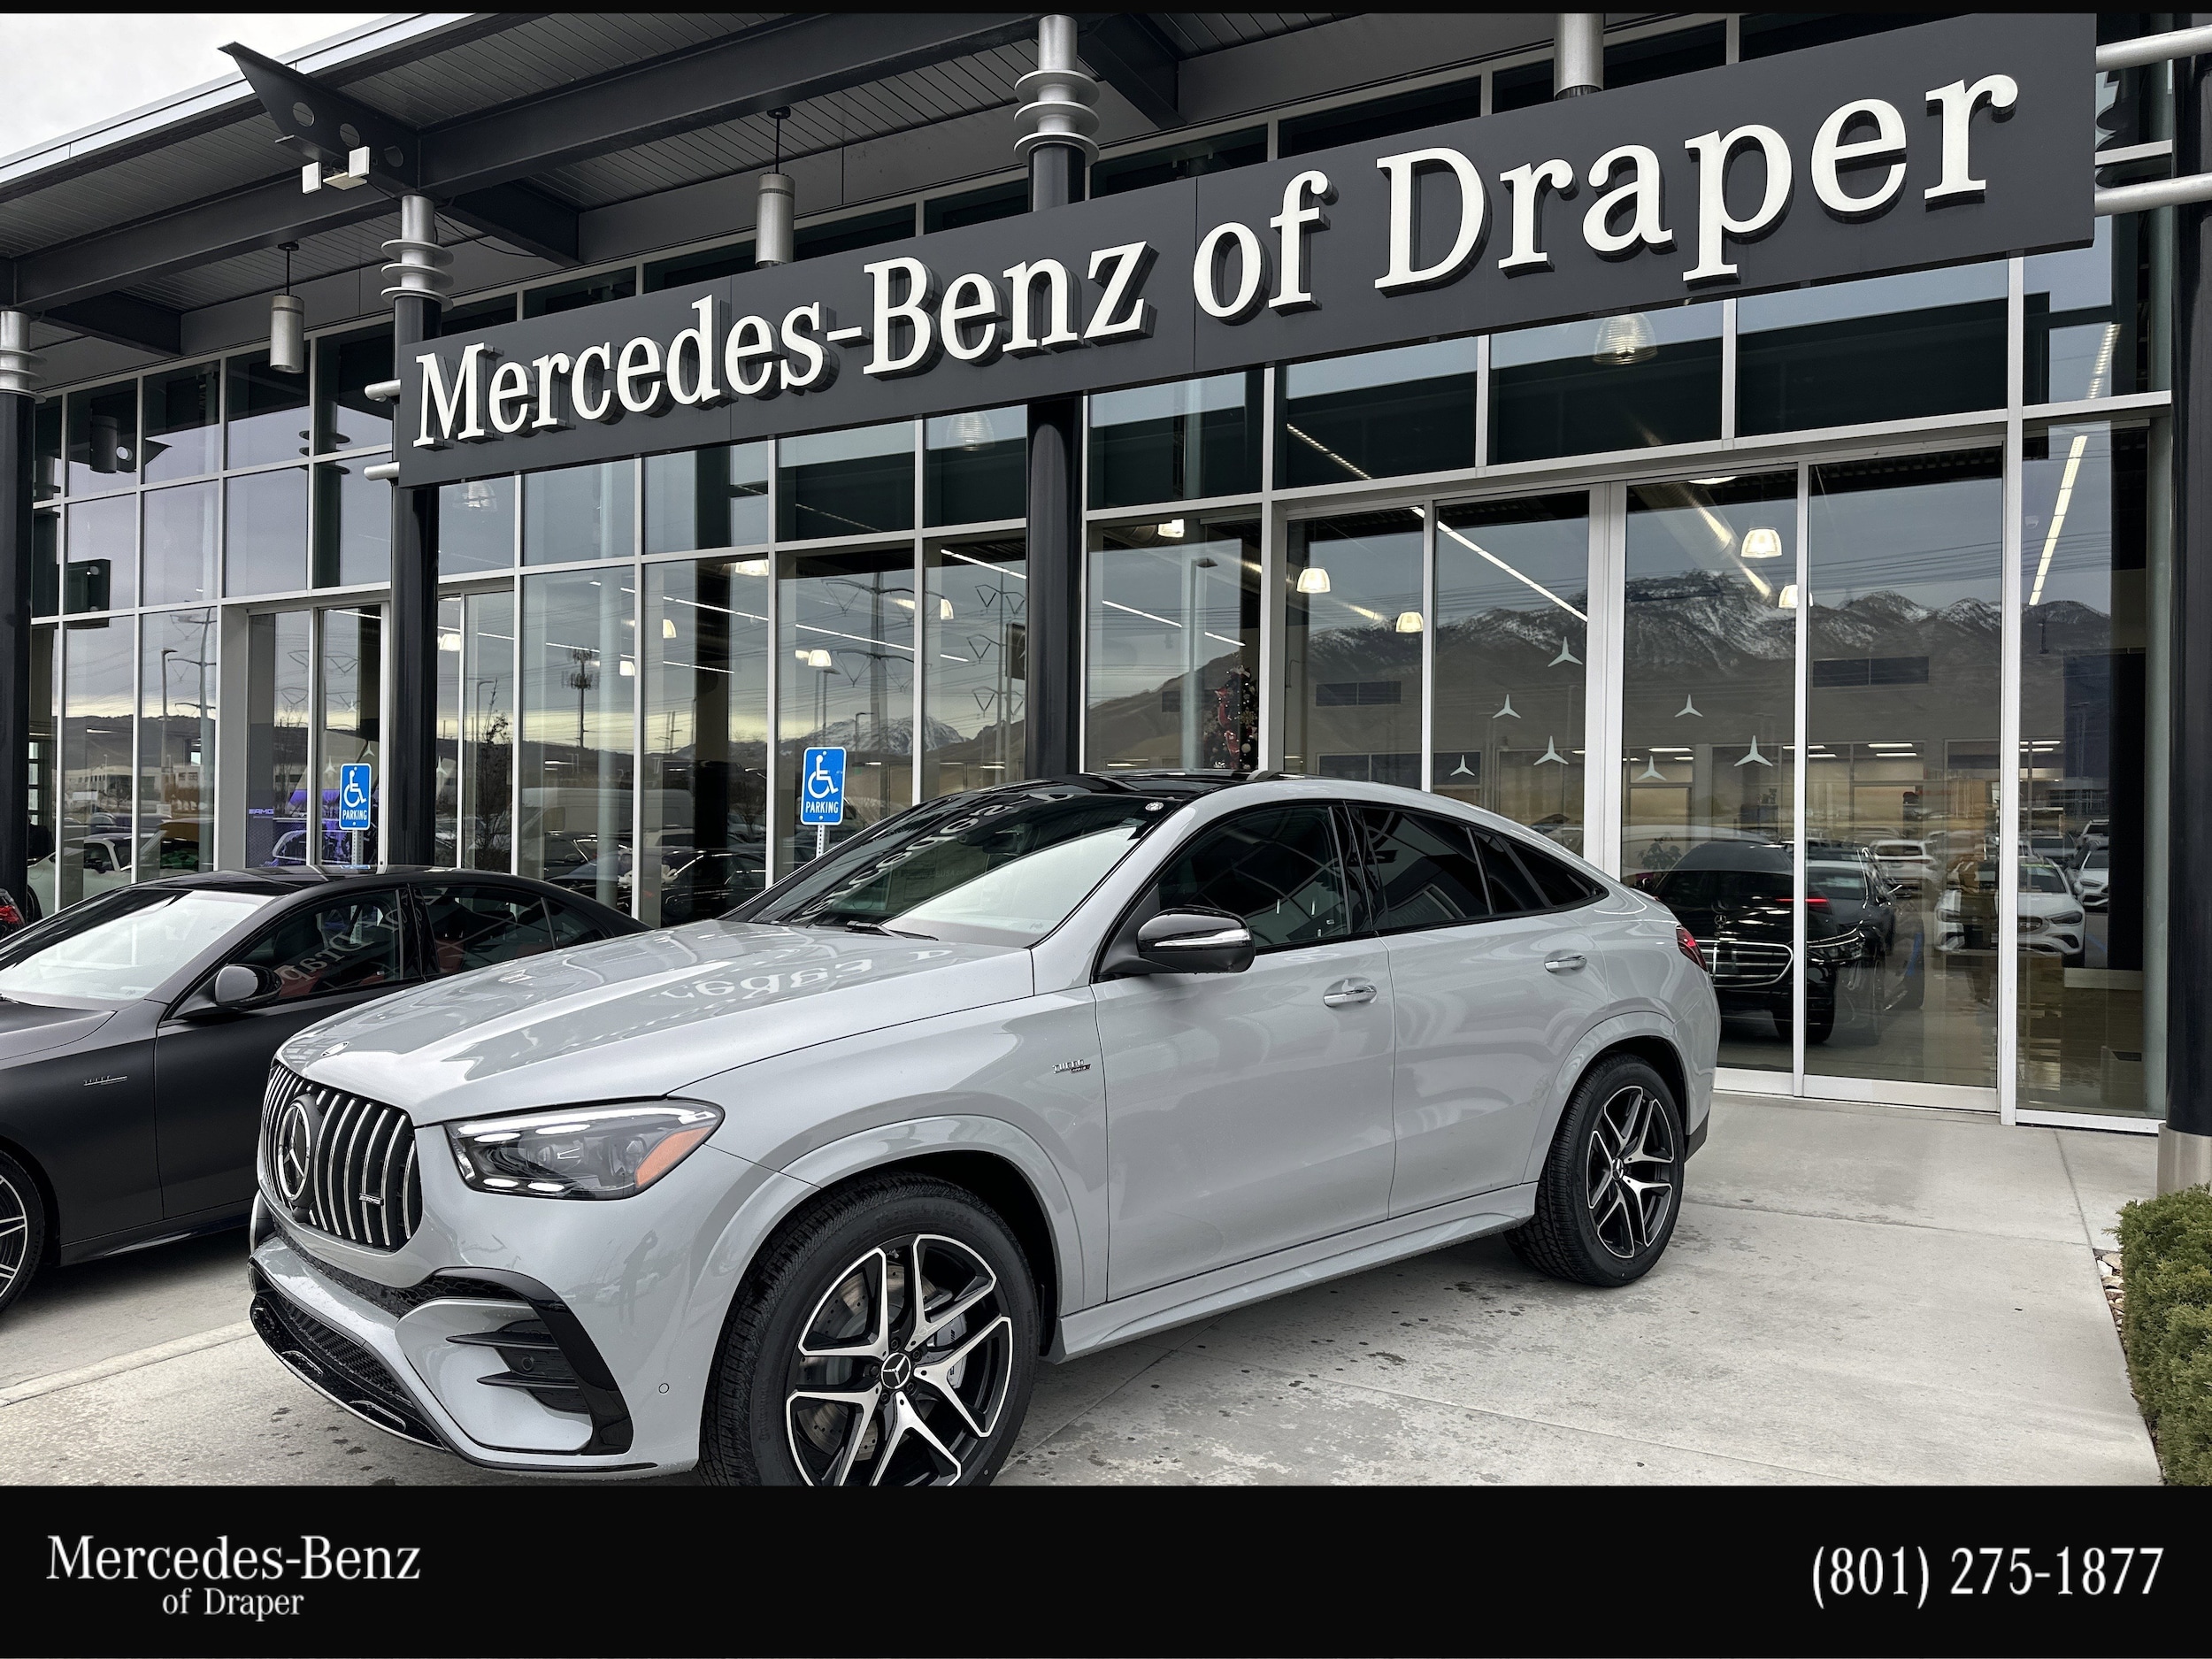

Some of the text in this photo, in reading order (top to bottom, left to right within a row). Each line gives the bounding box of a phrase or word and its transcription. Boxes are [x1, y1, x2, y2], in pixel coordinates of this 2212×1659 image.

[413, 73, 2018, 448] Mercedes-Benz of Draper
[805, 801, 839, 814] PARKING
[342, 810, 367, 820] PARKING
